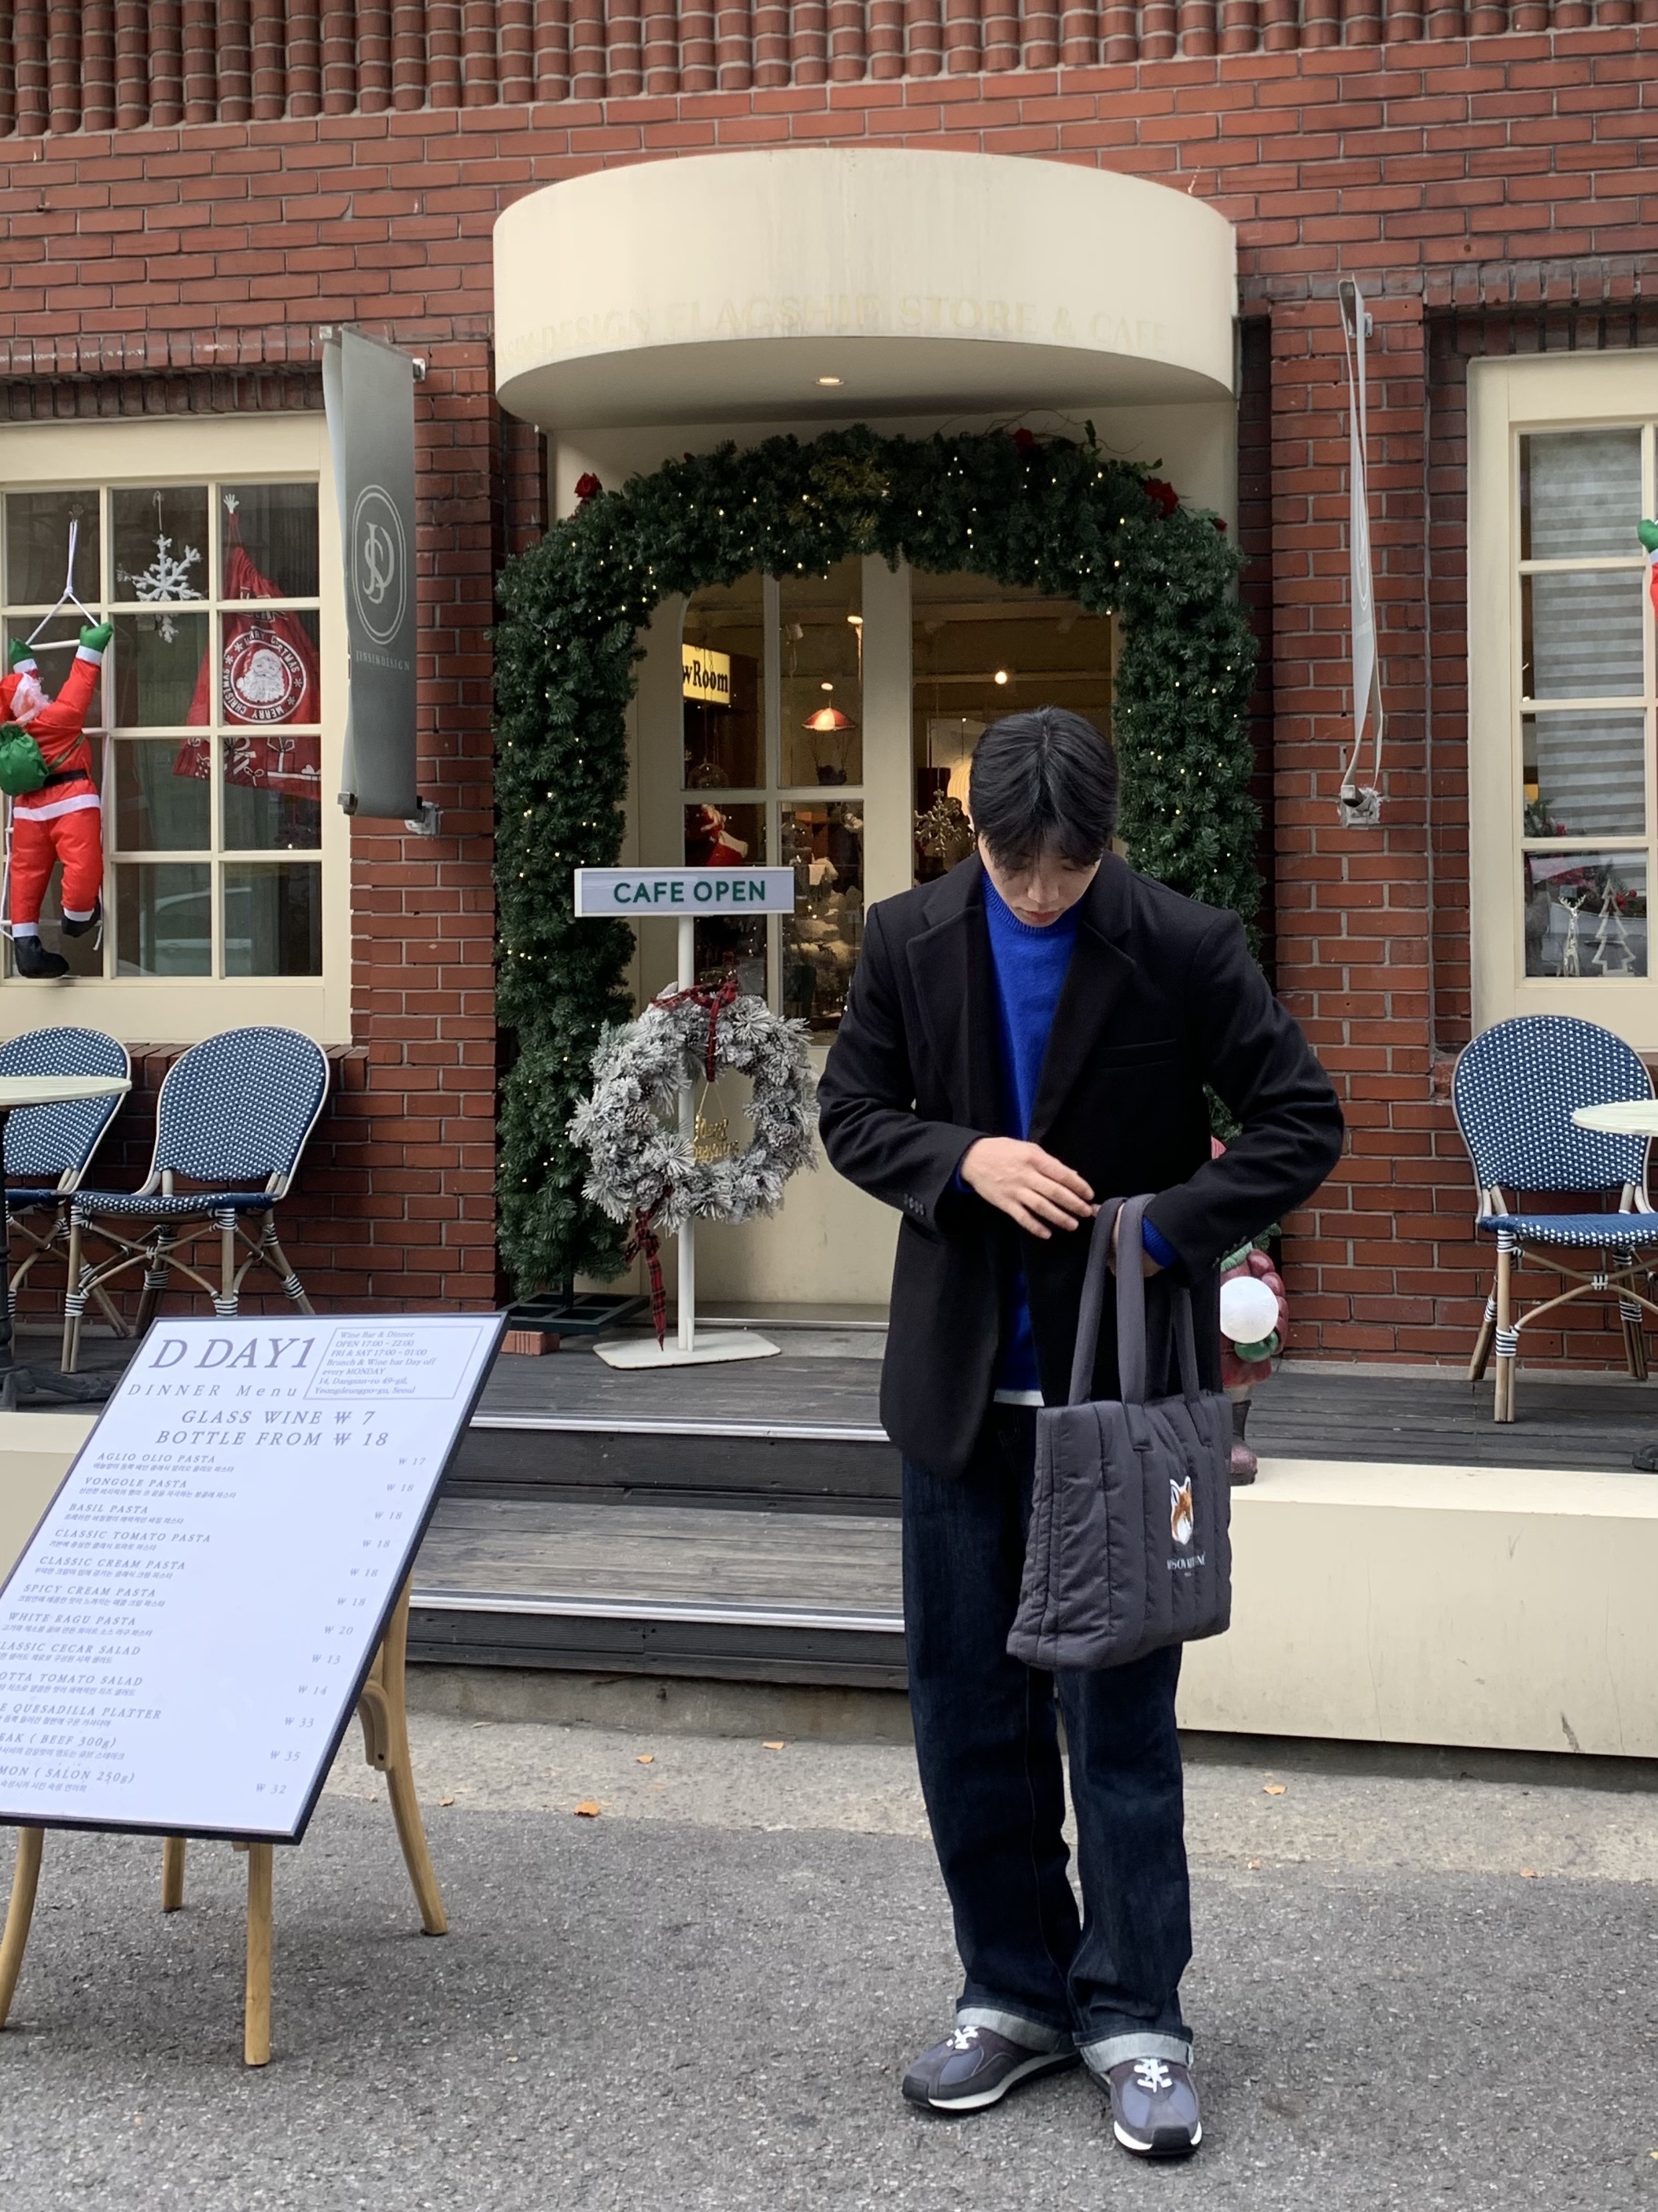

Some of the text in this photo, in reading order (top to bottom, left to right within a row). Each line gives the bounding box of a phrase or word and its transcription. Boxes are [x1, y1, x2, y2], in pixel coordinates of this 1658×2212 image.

[667, 295, 881, 334] FLAGSHIP
[899, 295, 1038, 334] STORE
[1090, 311, 1168, 354] CAFE
[251, 705, 285, 720] MERRY
[613, 881, 766, 903] CAFE OPEN
[335, 1340, 359, 1348] OPEN
[361, 1339, 383, 1348] 17:00
[391, 1339, 414, 1348] 22:00
[148, 1337, 315, 1368] D DAY1
[331, 1349, 346, 1357] FRI
[405, 1358, 422, 1367] Day
[345, 1367, 386, 1375] MONDAY
[128, 1384, 297, 1397] DINNER Menu
[392, 1386, 416, 1394] Seoul
[182, 1410, 252, 1424] GLASS
[265, 1410, 322, 1424] WINE
[362, 1410, 375, 1425] 7
[156, 1430, 246, 1445] BOTTLE
[255, 1432, 322, 1446] FROM
[362, 1432, 388, 1446] 18
[96, 1452, 215, 1464] AGLIO OLIO PASTA
[412, 1456, 426, 1466] 17
[85, 1476, 186, 1488] VONGOLE PASTA
[400, 1483, 414, 1492] 18
[68, 1503, 148, 1514] BASIL PASTA
[389, 1511, 403, 1520] 18
[55, 1529, 210, 1543] CLASSIC TOMATO PASTA
[376, 1539, 391, 1549] 18
[39, 1556, 185, 1570] CLASSIC CREAM PASTA
[364, 1568, 379, 1577] 18
[23, 1583, 155, 1597] SPICY CREAM PASTA
[352, 1597, 367, 1607] 18
[8, 1612, 136, 1626] WHITE RAGU PASTA
[338, 1625, 354, 1635] 20
[0, 1641, 140, 1655] LASSIC CECAR SALAD
[326, 1655, 341, 1665] 13
[39, 1673, 95, 1684] TOMATO
[100, 1675, 143, 1686] SALAD
[313, 1685, 328, 1696] 14
[13, 1703, 95, 1716] QUESADILLA
[102, 1707, 161, 1719] PLATTER
[298, 1718, 315, 1728] 33
[39, 1734, 74, 1745] BEEF
[283, 1751, 301, 1762] 35
[44, 1768, 91, 1781] SALON
[270, 1784, 287, 1794] 32
